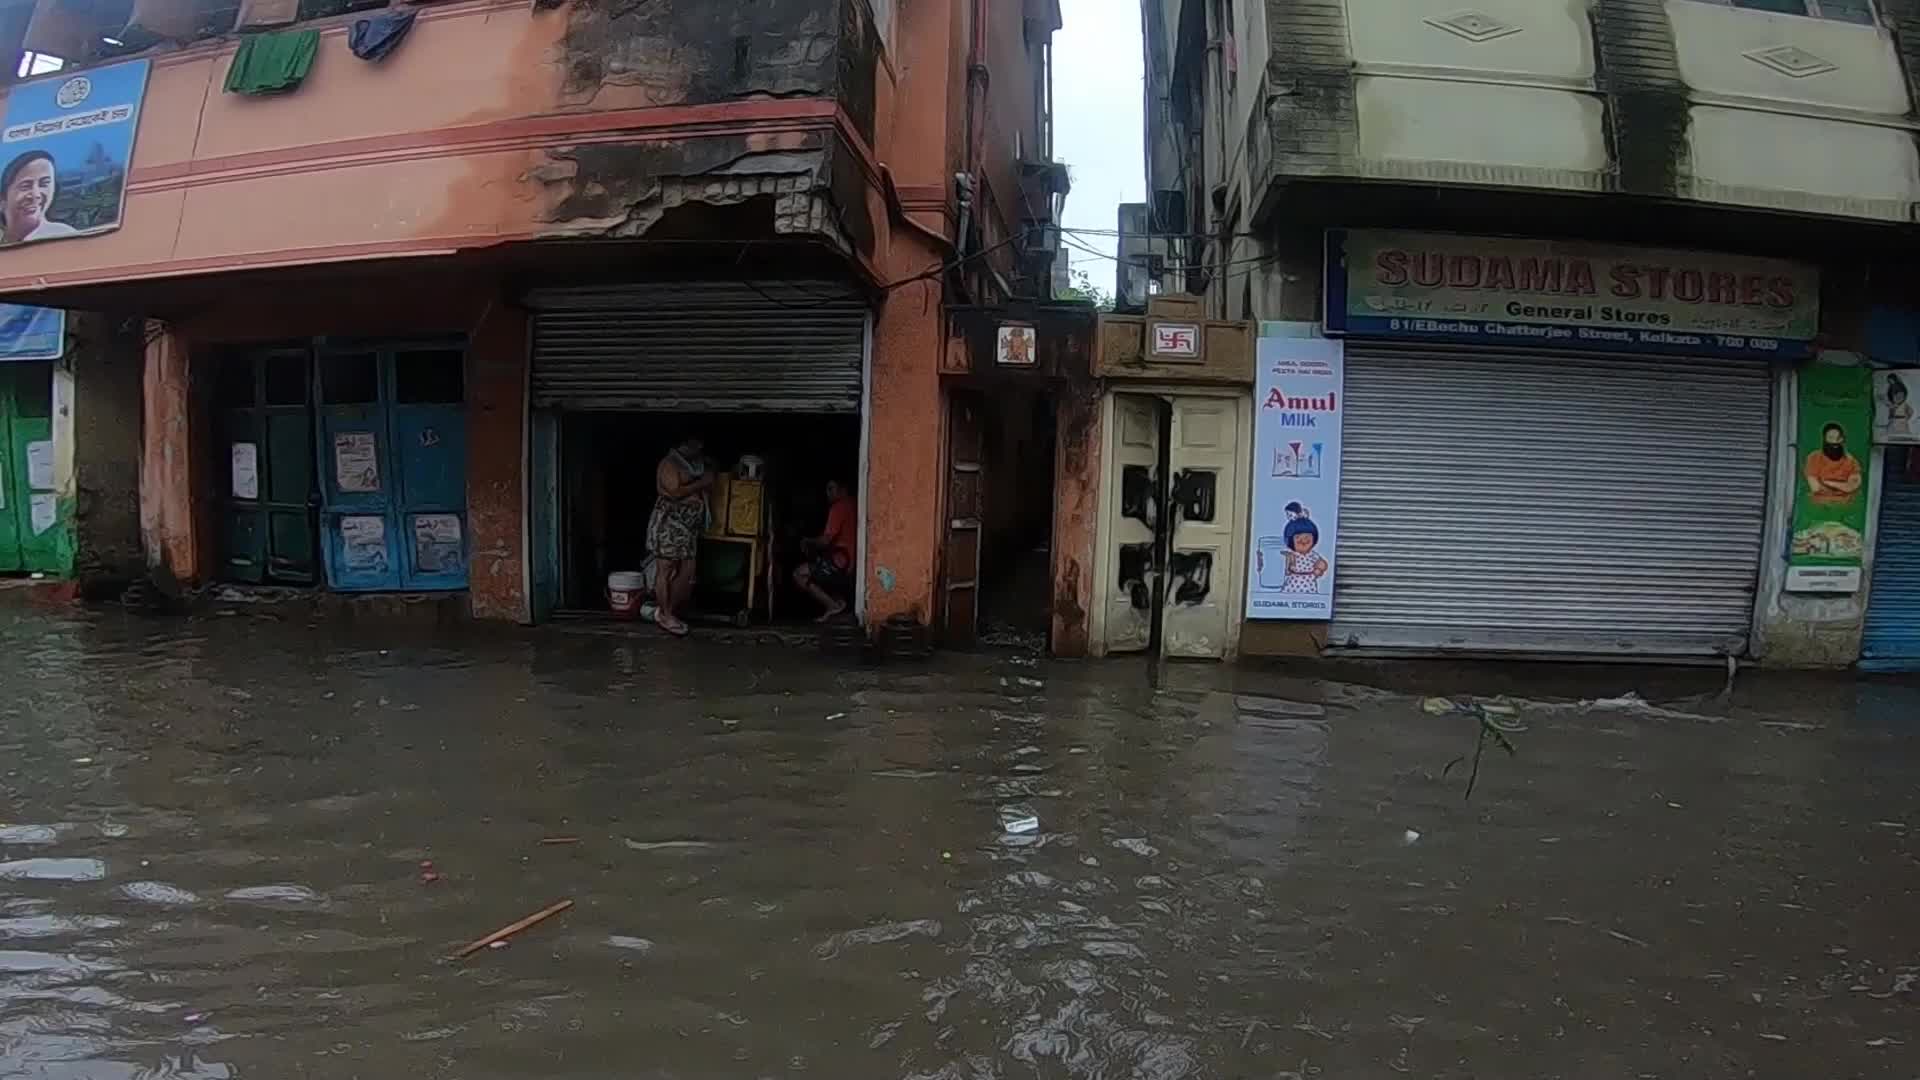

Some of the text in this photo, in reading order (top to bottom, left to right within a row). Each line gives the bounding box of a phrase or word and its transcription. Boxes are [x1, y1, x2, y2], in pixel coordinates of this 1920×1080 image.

[1375, 249, 1795, 308] SUDAMA STORES
[1506, 302, 1593, 320] General
[1600, 307, 1671, 324] Stores
[1484, 321, 1572, 338] Chatterjee
[1578, 328, 1634, 342] Street,
[1640, 332, 1702, 345] Kolkata
[1263, 387, 1335, 411] Amul
[1281, 413, 1316, 427] Milk
